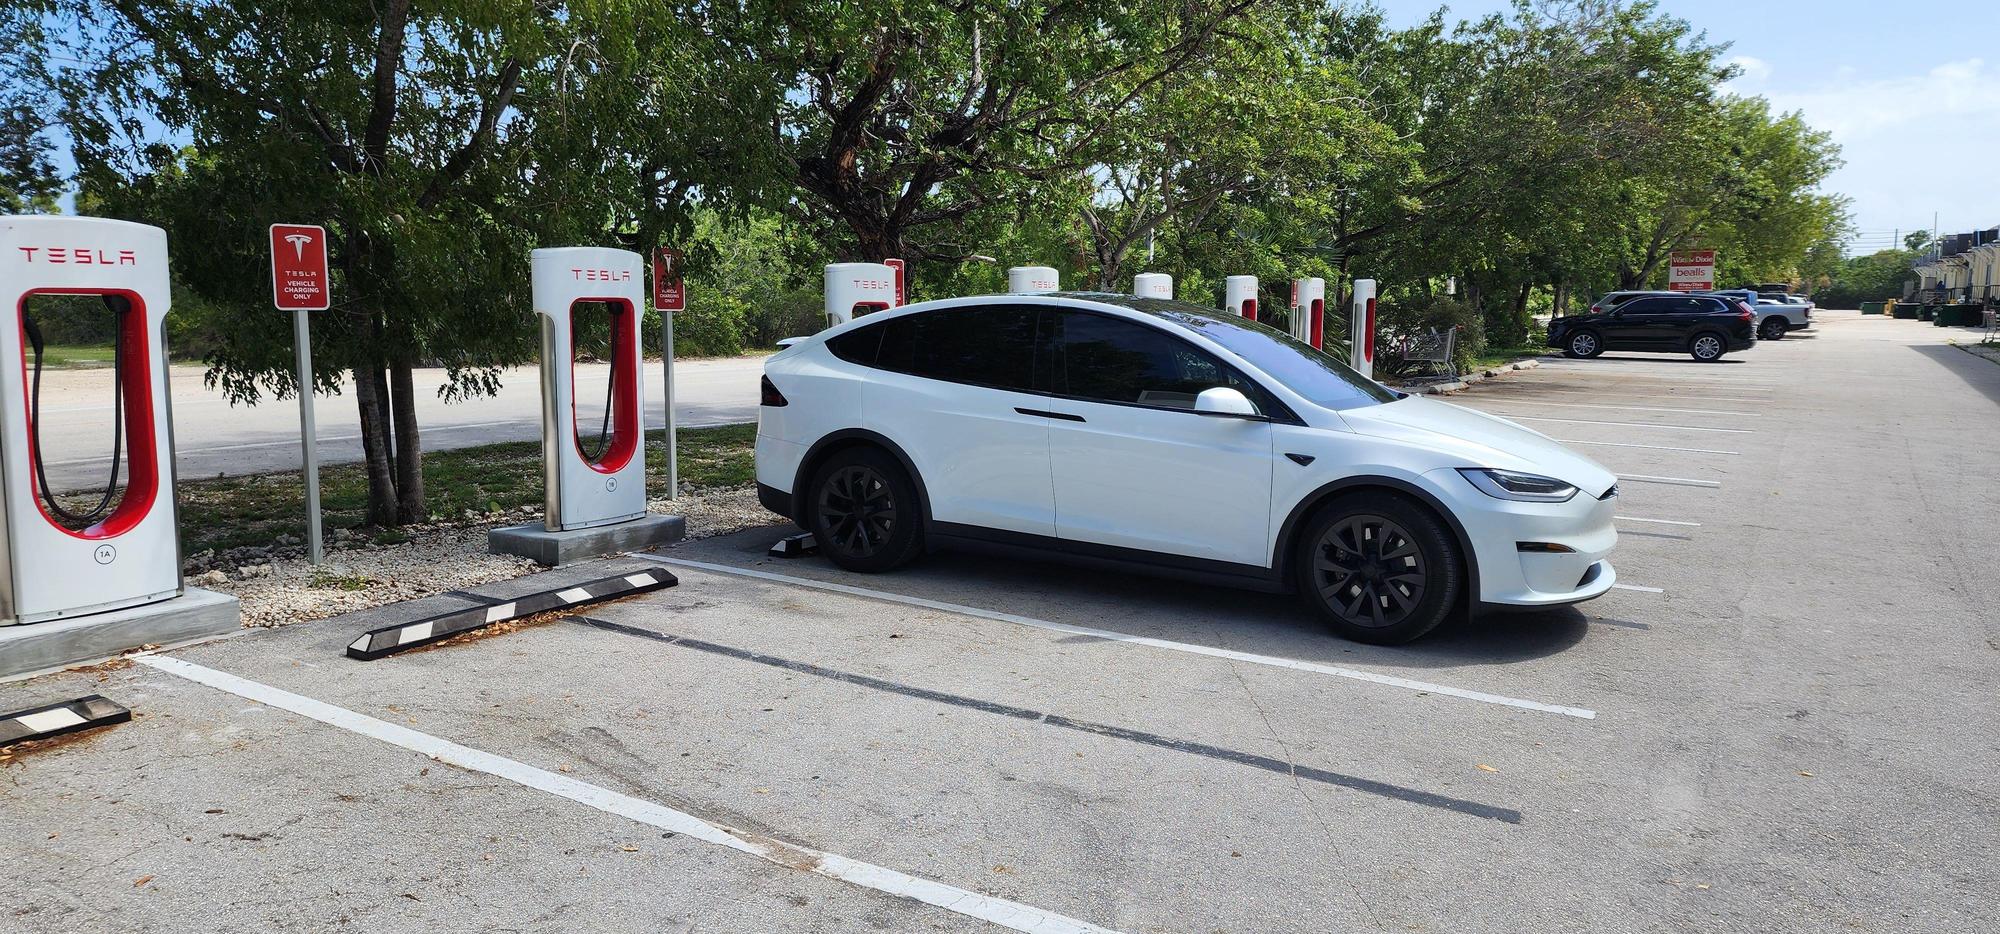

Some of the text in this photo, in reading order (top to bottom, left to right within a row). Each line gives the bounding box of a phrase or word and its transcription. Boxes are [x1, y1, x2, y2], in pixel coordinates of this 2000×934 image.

[18, 247, 136, 265] TESLA
[571, 269, 631, 281] TESLA
[1676, 268, 1706, 276] bealls
[853, 280, 889, 289] TESLA
[100, 550, 111, 558] 1A
